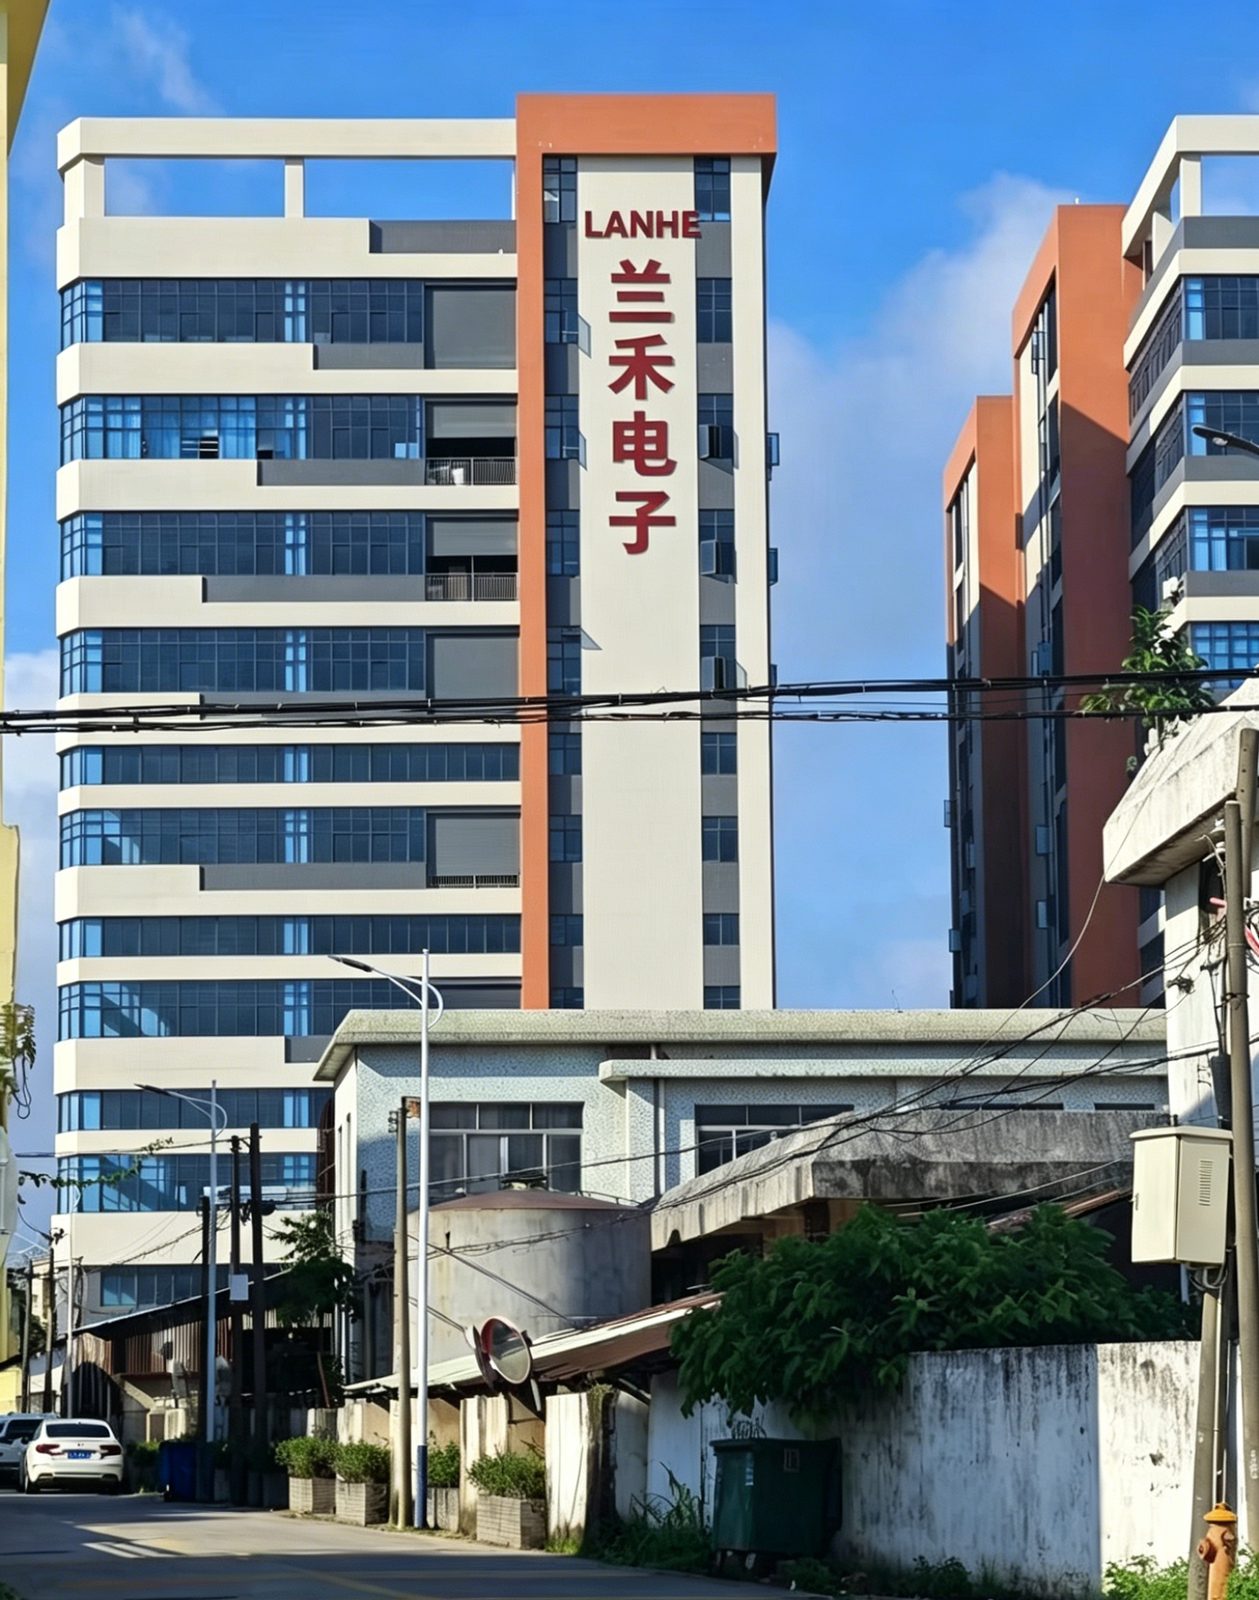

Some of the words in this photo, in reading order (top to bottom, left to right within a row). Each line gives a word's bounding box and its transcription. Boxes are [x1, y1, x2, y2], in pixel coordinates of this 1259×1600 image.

[585, 210, 702, 239] LANHE
[608, 259, 677, 555] 兰禾电子
